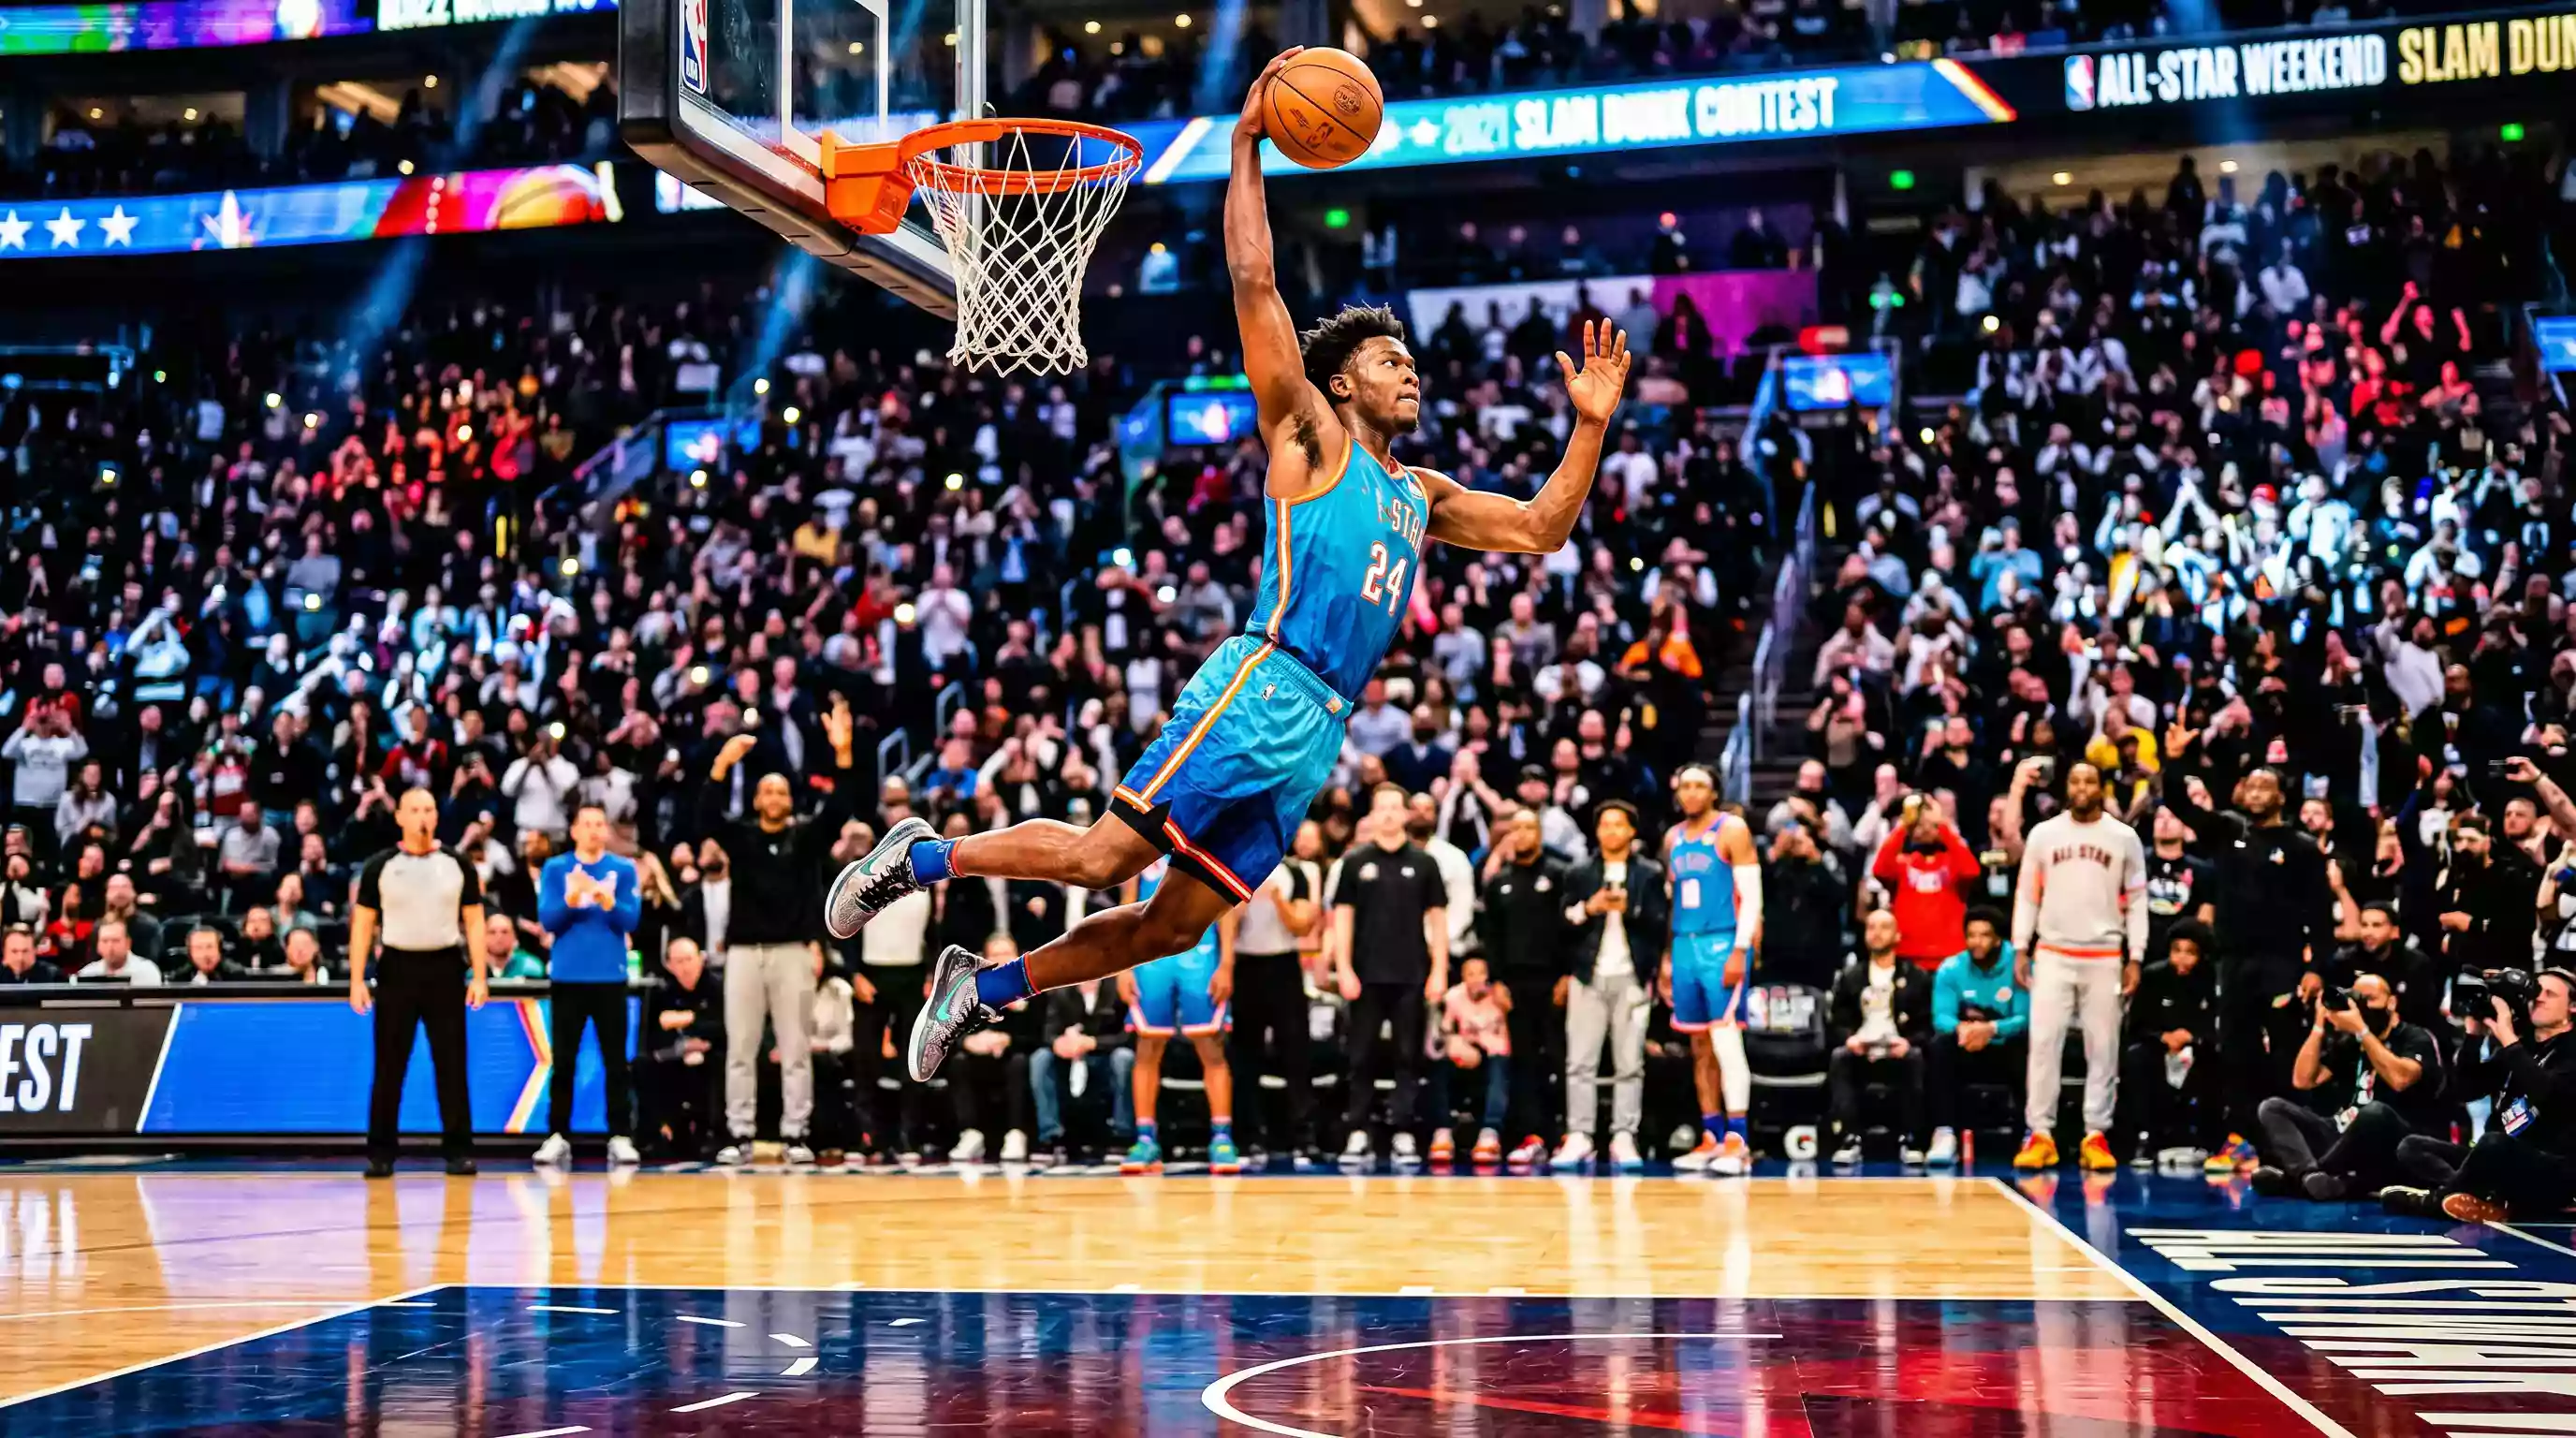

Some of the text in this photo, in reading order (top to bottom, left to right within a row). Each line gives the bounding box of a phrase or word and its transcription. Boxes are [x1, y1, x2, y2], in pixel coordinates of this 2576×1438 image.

[2097, 46, 2239, 108] ALL-STAR
[2240, 34, 2387, 96] WEEKEND
[2398, 22, 2500, 85] SLAM
[1514, 94, 1599, 151] SLAM
[1695, 77, 1839, 138] CONTEST
[1360, 540, 1409, 619] 24
